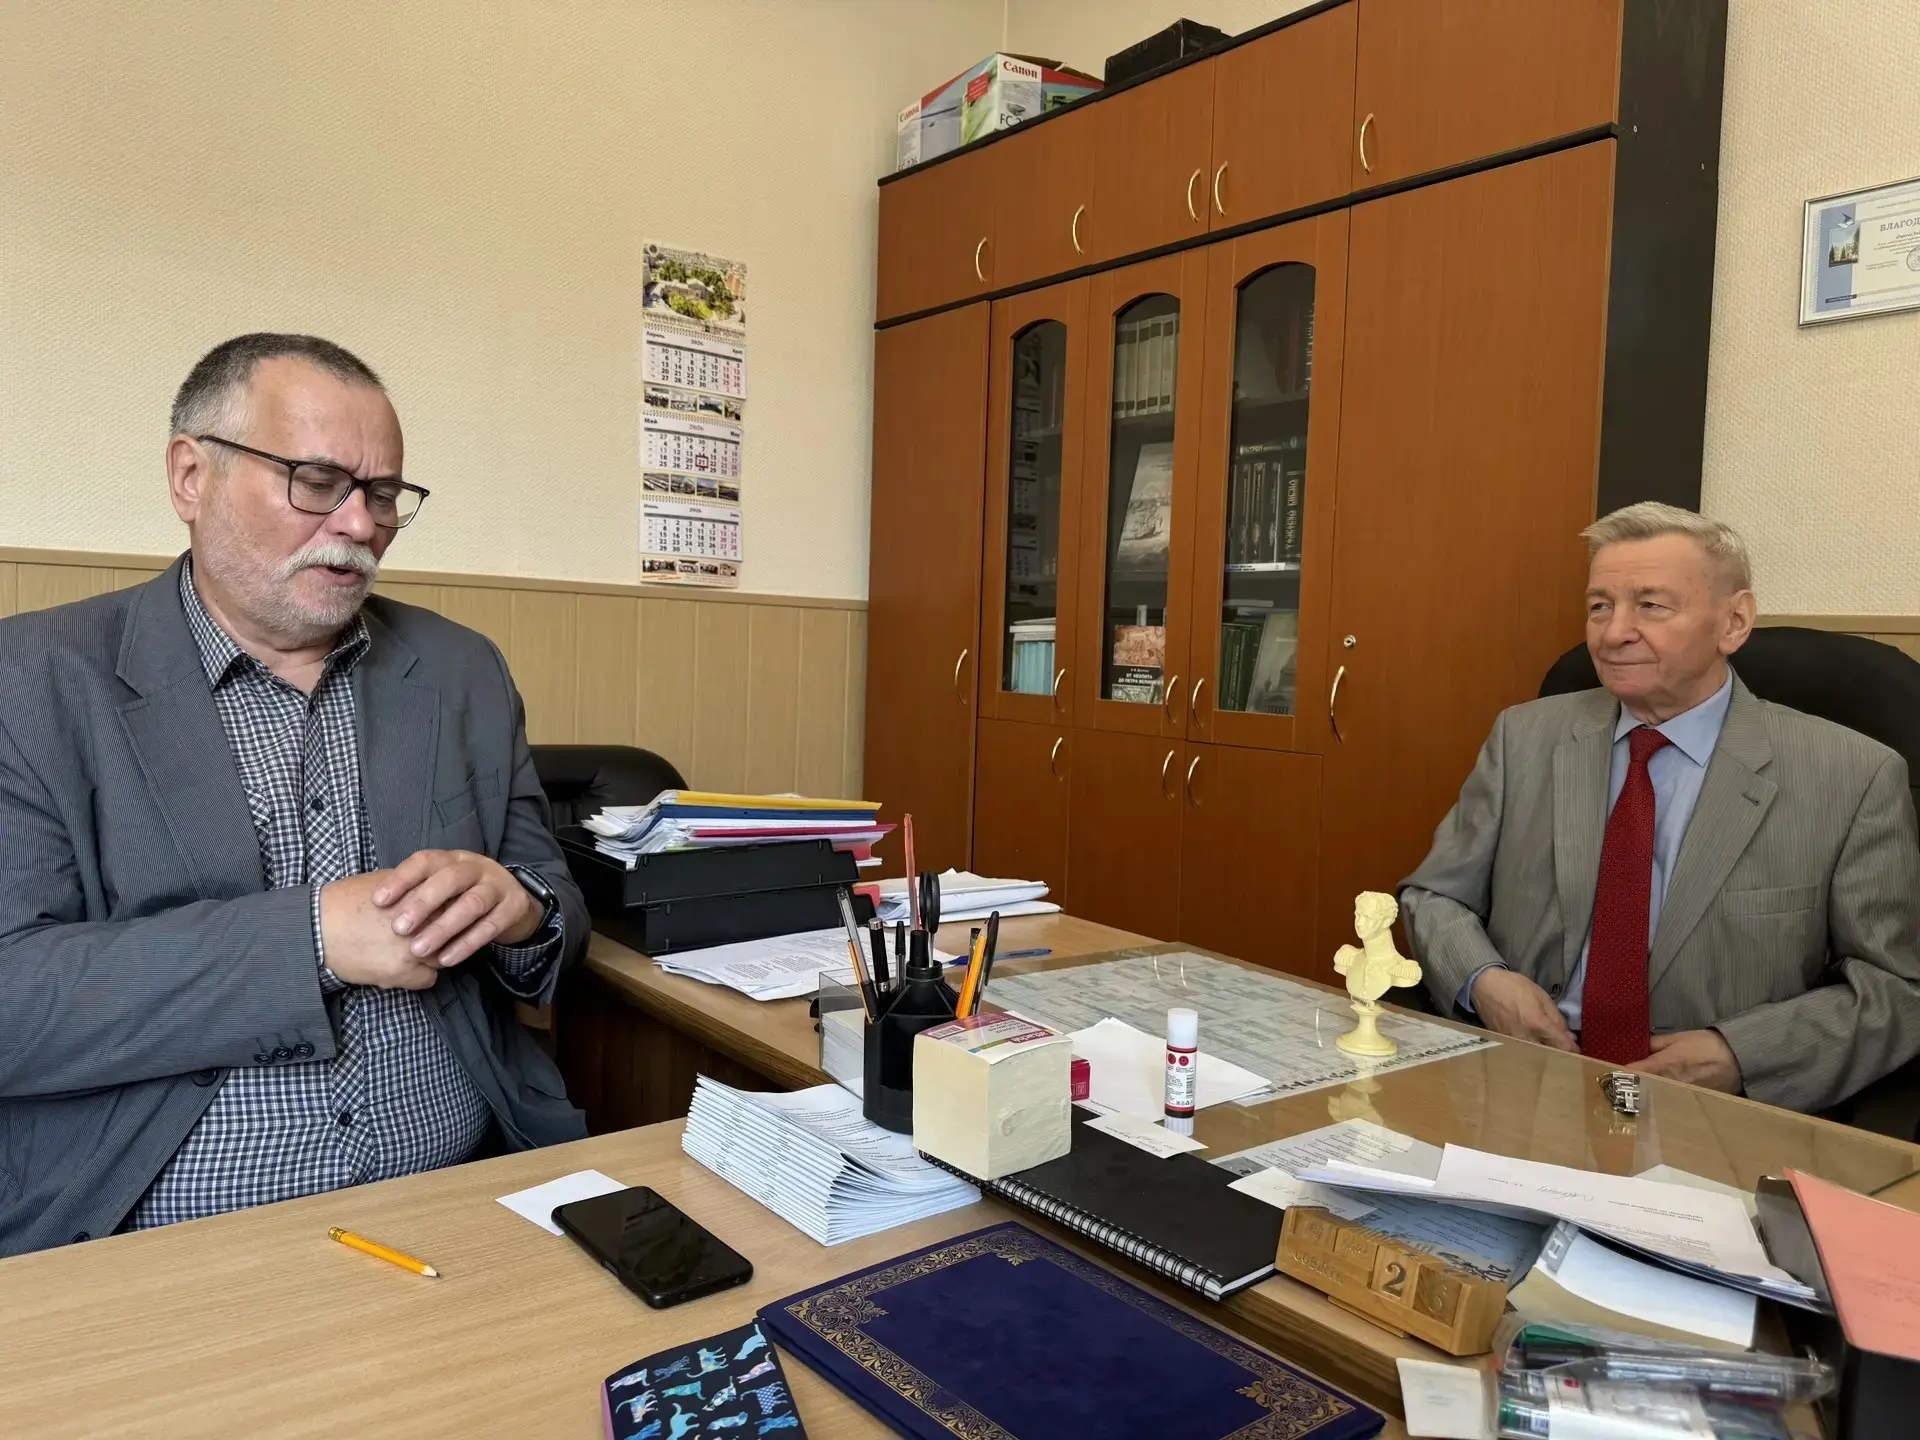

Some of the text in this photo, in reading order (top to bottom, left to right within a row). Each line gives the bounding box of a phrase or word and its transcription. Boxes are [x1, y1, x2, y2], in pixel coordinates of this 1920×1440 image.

[1003, 60, 1038, 80] Canon
[900, 105, 920, 123] Canon
[1880, 218, 1920, 232] БЛАГОД
[1381, 1262, 1407, 1298] 2
